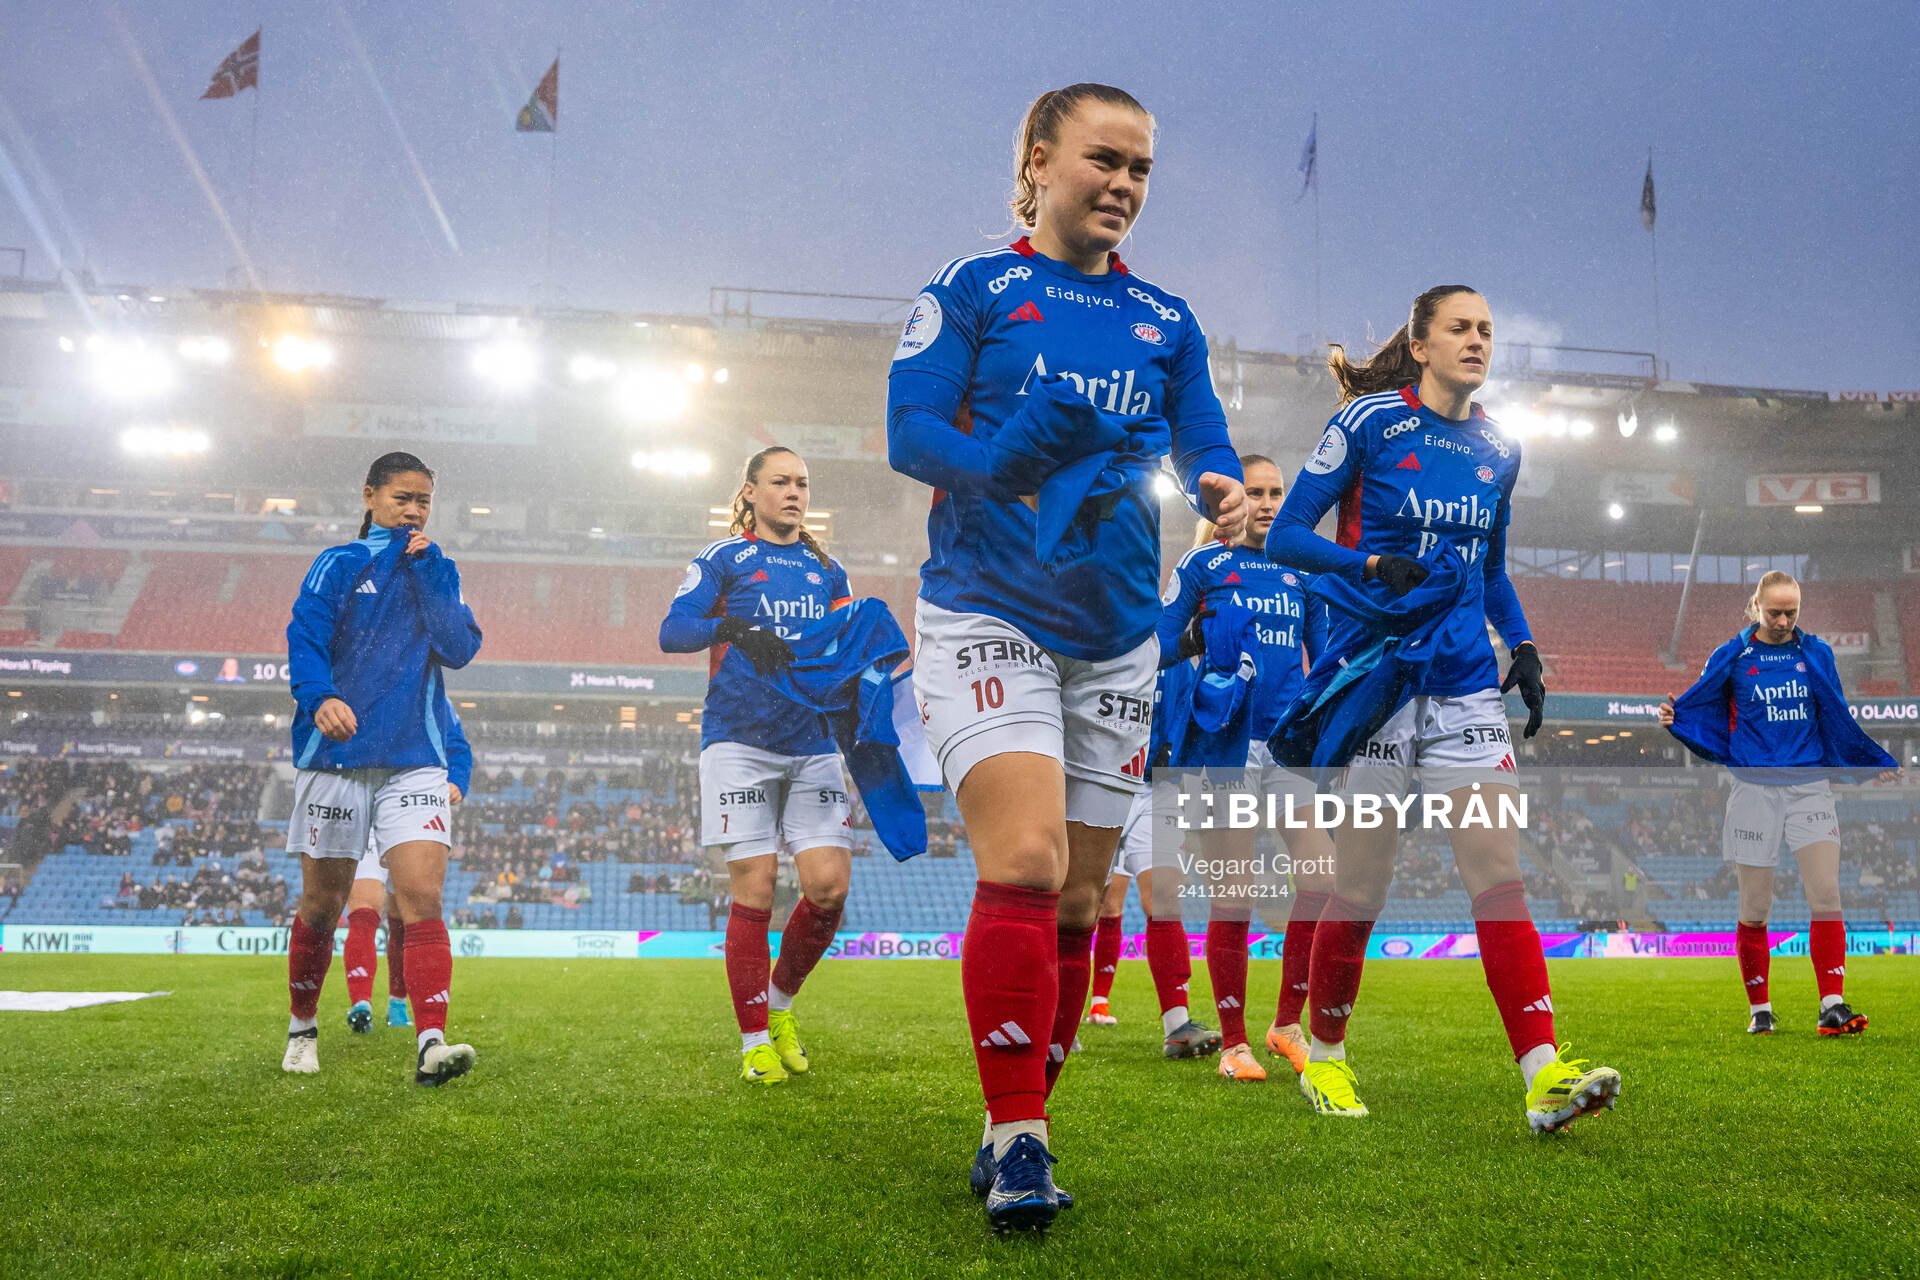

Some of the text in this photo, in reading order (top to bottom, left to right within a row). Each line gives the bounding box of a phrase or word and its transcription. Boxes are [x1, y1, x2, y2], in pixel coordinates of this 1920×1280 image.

[988, 265, 1033, 294] coop
[1126, 286, 1182, 322] coop
[1383, 415, 1421, 440] coop
[1763, 478, 1862, 501] VG
[1395, 487, 1491, 530] Aprila
[734, 545, 759, 564] coop
[1416, 530, 1483, 566] Bnk
[1207, 550, 1233, 570] coop
[753, 592, 826, 623] Aprila
[0, 658, 71, 674] Norsk Tipping
[253, 663, 276, 680] 10
[971, 676, 1004, 713] 10
[1750, 679, 1809, 704] Aprila
[1097, 693, 1153, 726] STER
[1766, 703, 1808, 722] Bank
[1861, 704, 1919, 720] OLAUG
[1355, 741, 1398, 760] ERK
[400, 794, 447, 808] STERK
[720, 790, 766, 806] STERK
[820, 790, 849, 804] STE
[308, 803, 354, 821] STERK
[721, 814, 729, 833] 7
[23, 932, 69, 951] KIWI
[828, 938, 950, 957] SENBORG
[1631, 935, 1738, 954] Velkomme
